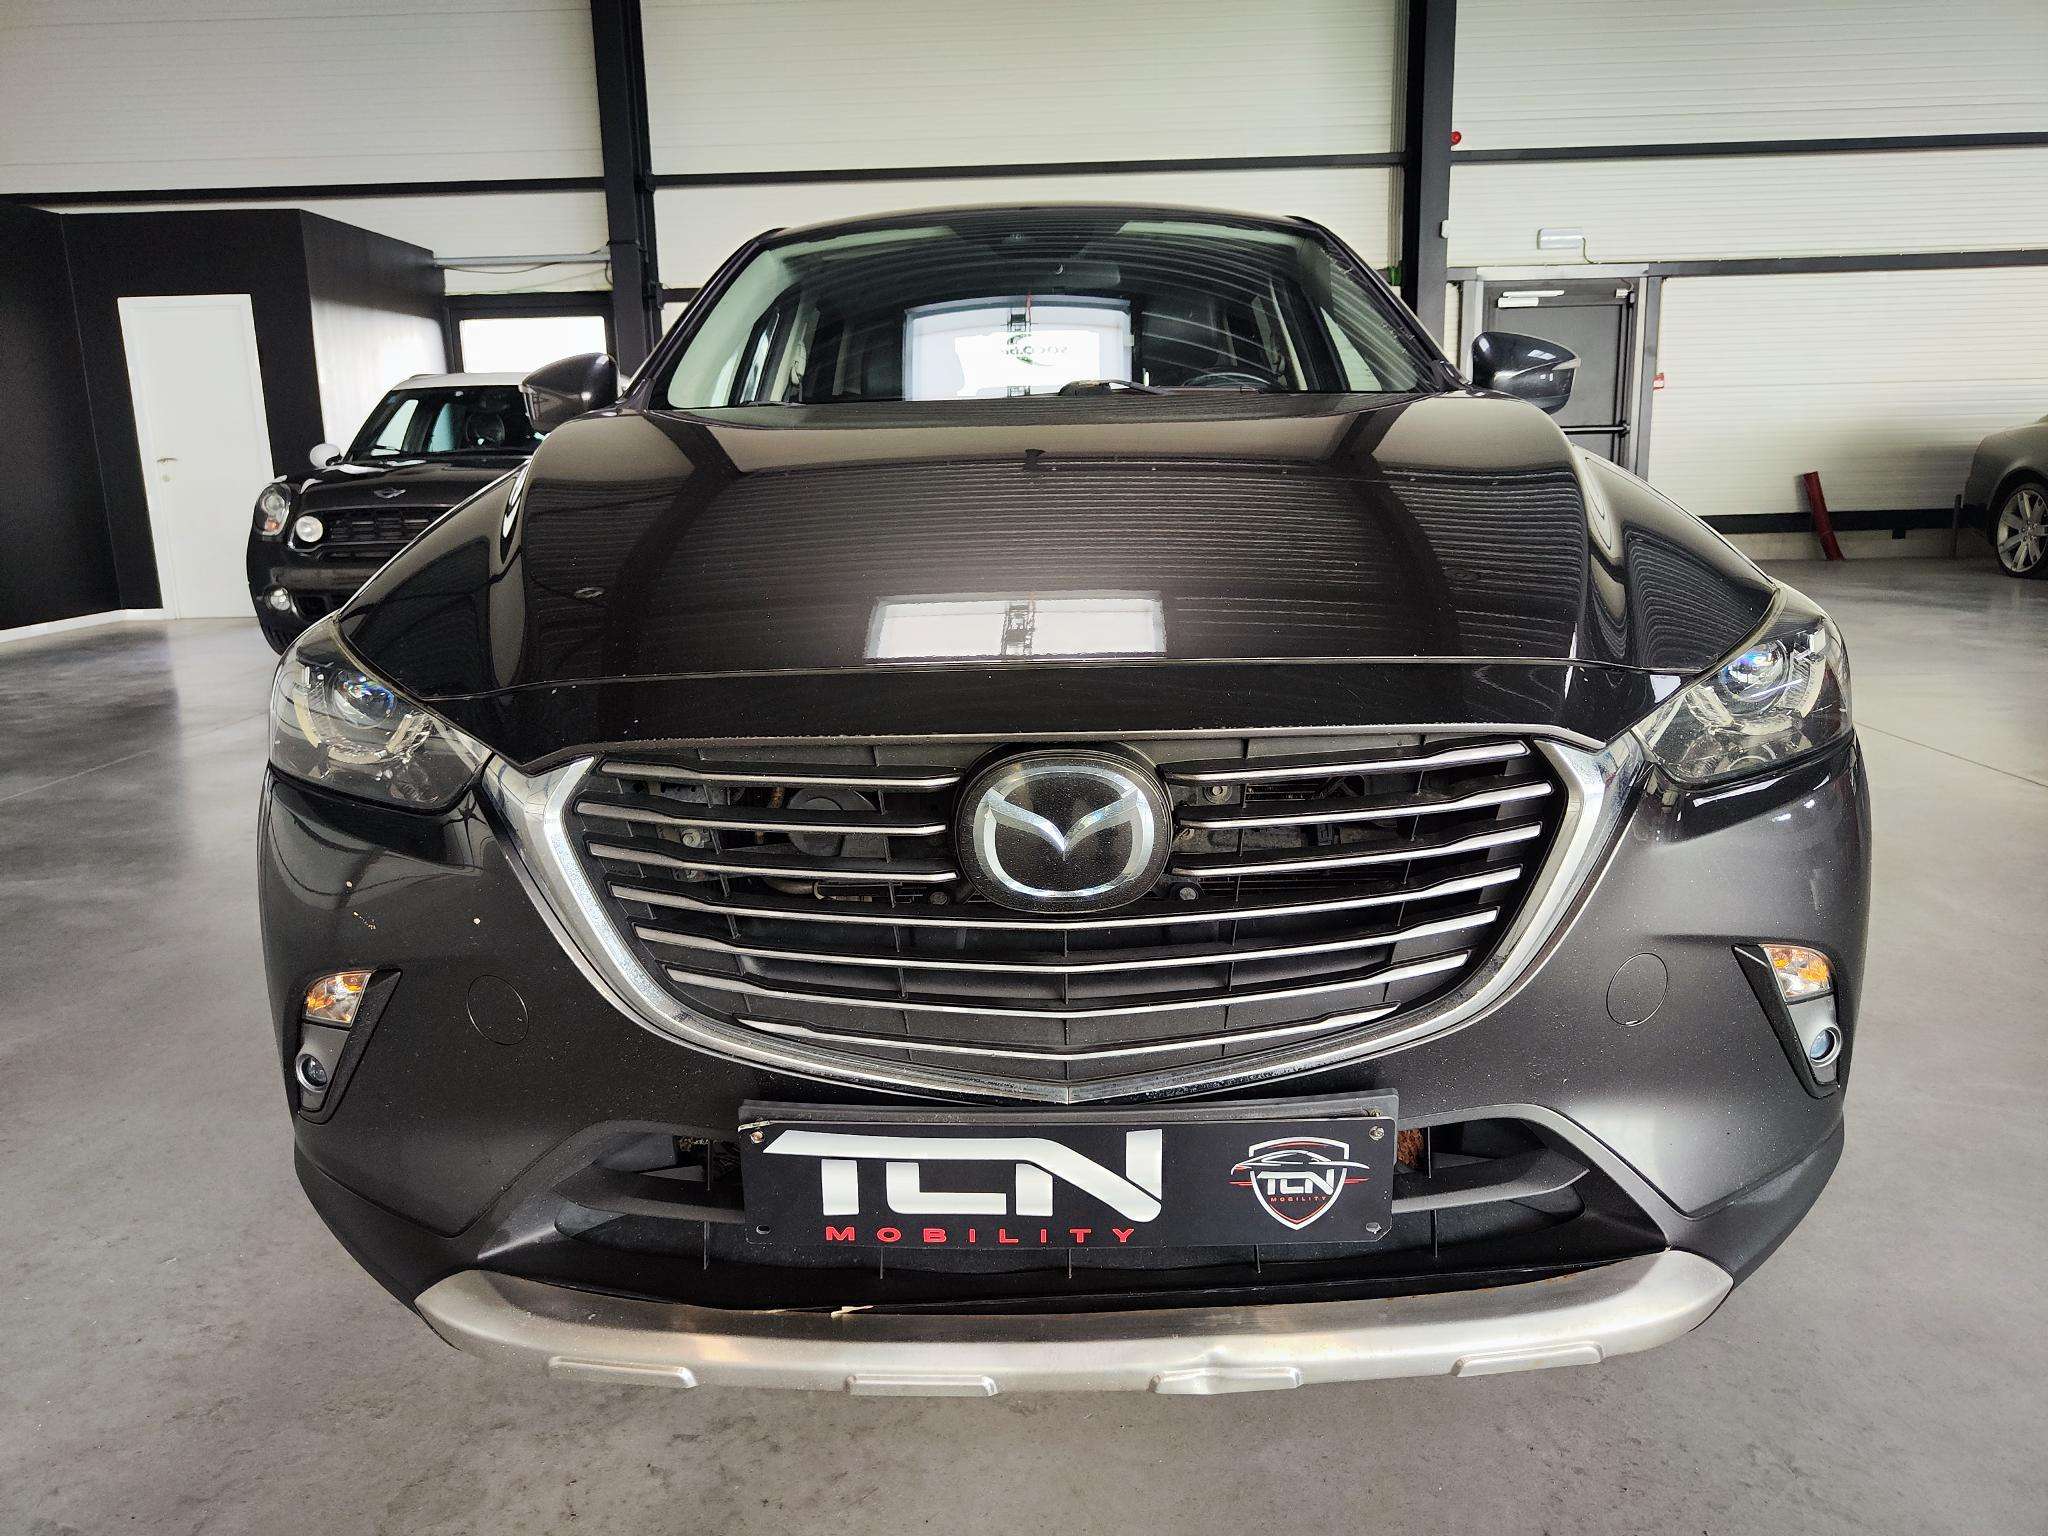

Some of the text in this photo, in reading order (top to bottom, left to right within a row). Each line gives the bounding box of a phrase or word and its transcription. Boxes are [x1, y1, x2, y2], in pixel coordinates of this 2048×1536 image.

[763, 1128, 1163, 1223] TCN
[1257, 1168, 1335, 1196] TCN
[825, 1226, 1135, 1244] MOBILITY
